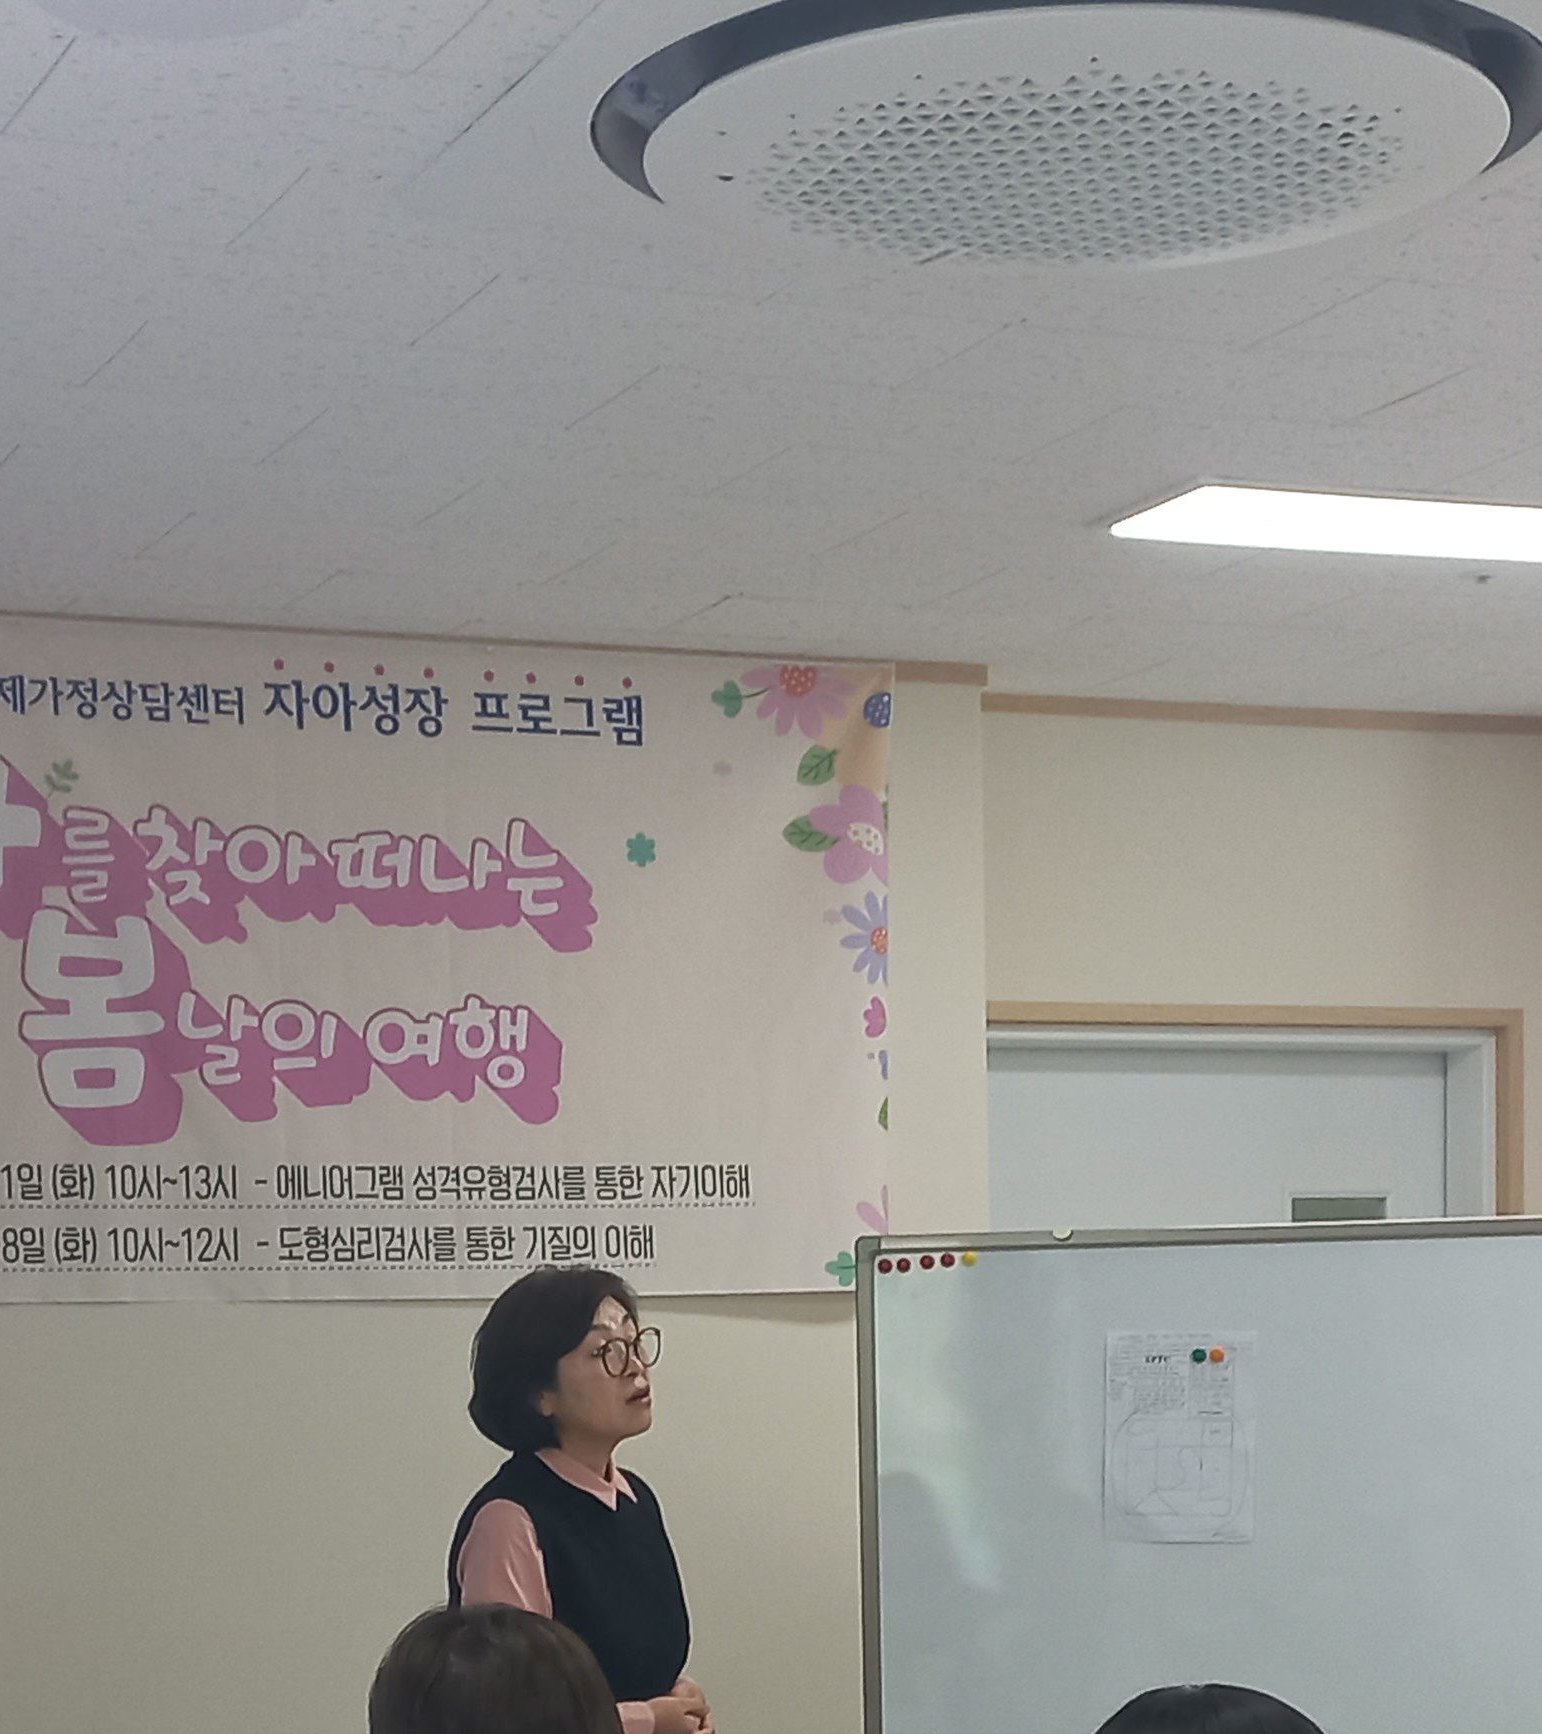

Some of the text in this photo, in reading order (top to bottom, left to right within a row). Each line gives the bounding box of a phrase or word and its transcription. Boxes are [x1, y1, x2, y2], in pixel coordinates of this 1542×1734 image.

[263, 677, 449, 738] 자아성장
[471, 691, 644, 747] 프로그램
[329, 816, 577, 928] 떠나는
[363, 993, 541, 1098] 여행
[104, 1164, 237, 1201] 10시~13시
[276, 1164, 404, 1201] 에니어그램
[412, 1165, 587, 1201] 성격유형검사를
[594, 1164, 645, 1201] 통한
[650, 1163, 751, 1202] 자기이해
[106, 1226, 239, 1264] 10시~12시
[278, 1225, 457, 1263] 도형심리검사를
[465, 1225, 516, 1262] 통한
[522, 1225, 597, 1261] 기질의
[604, 1223, 655, 1261] 이해
